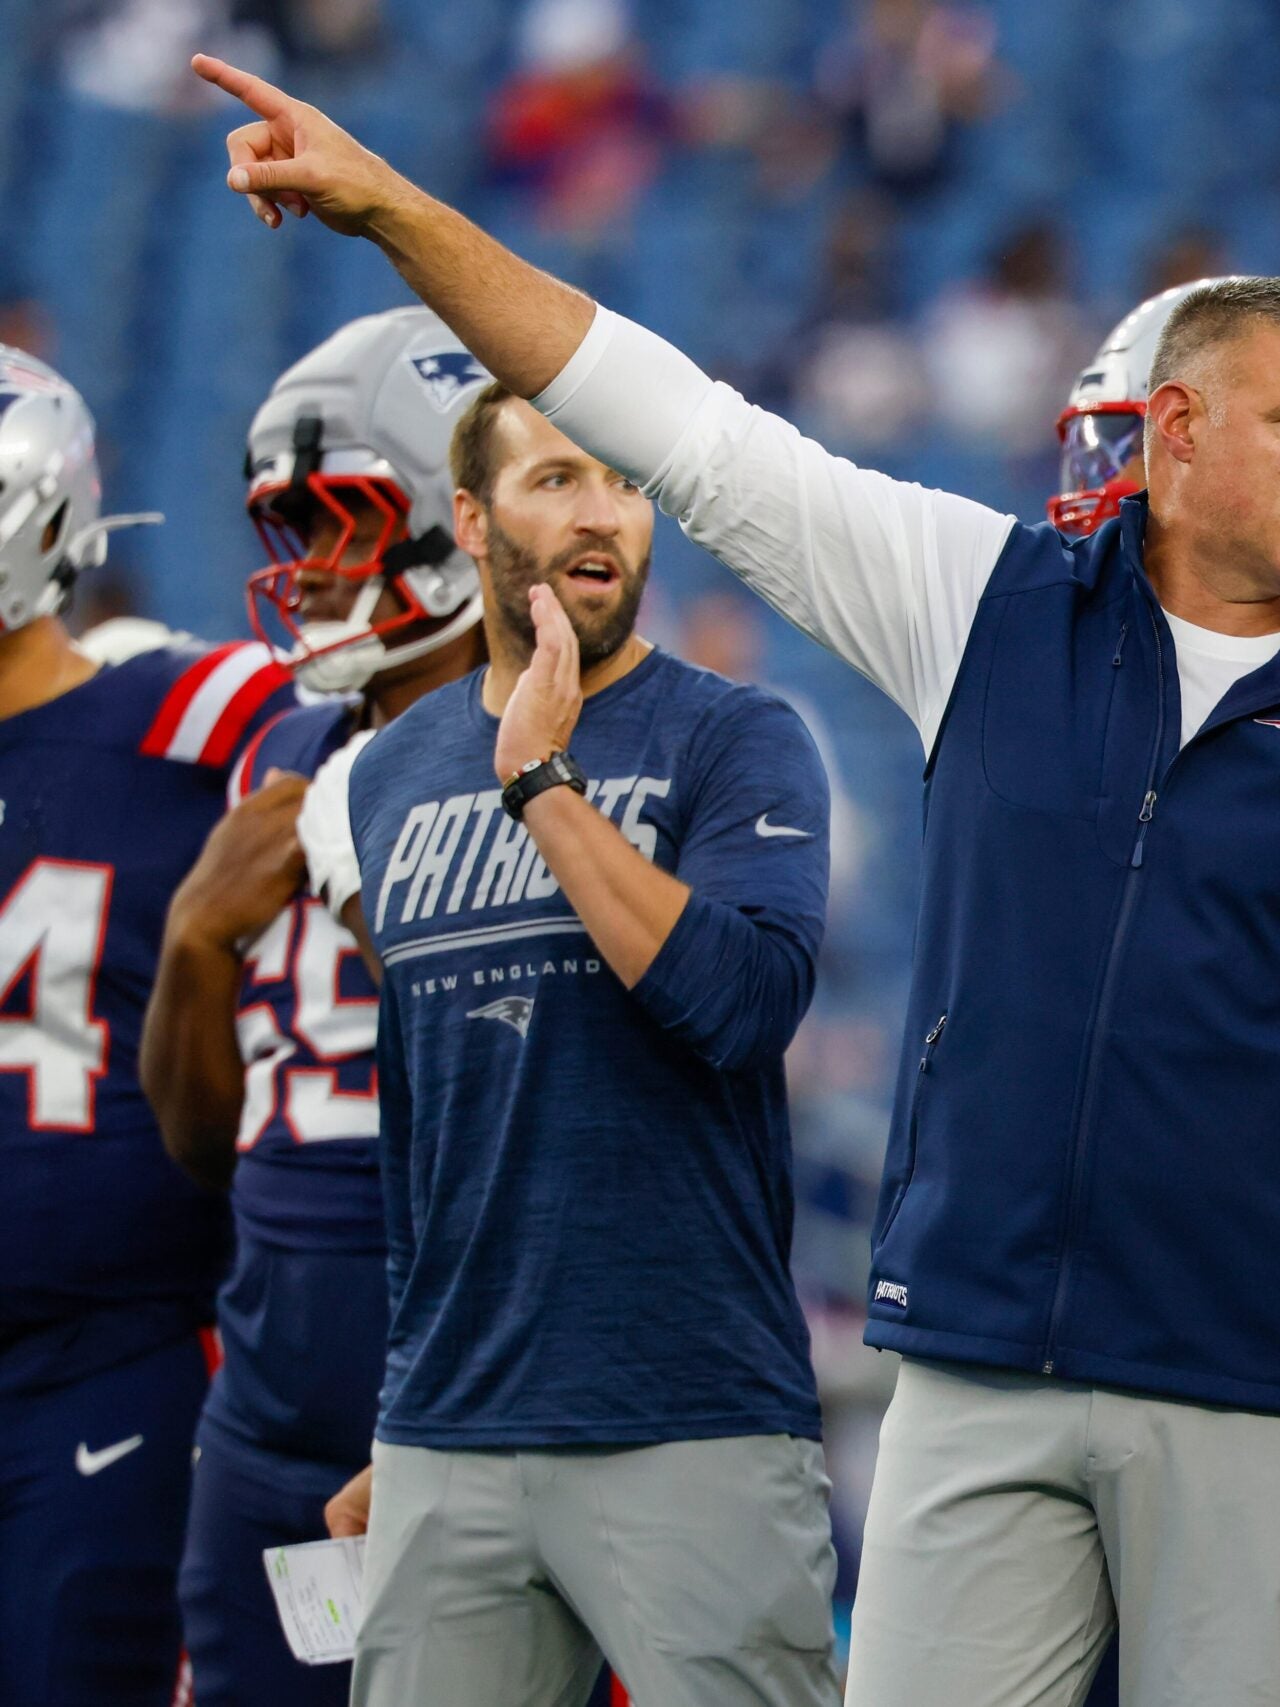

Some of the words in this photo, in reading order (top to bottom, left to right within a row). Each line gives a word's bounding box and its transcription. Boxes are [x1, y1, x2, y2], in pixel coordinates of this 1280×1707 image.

[0, 855, 115, 1134] 4
[411, 975, 458, 998] NEW
[473, 959, 601, 986] ENGLAND
[874, 1280, 908, 1308] PATRIOTS
